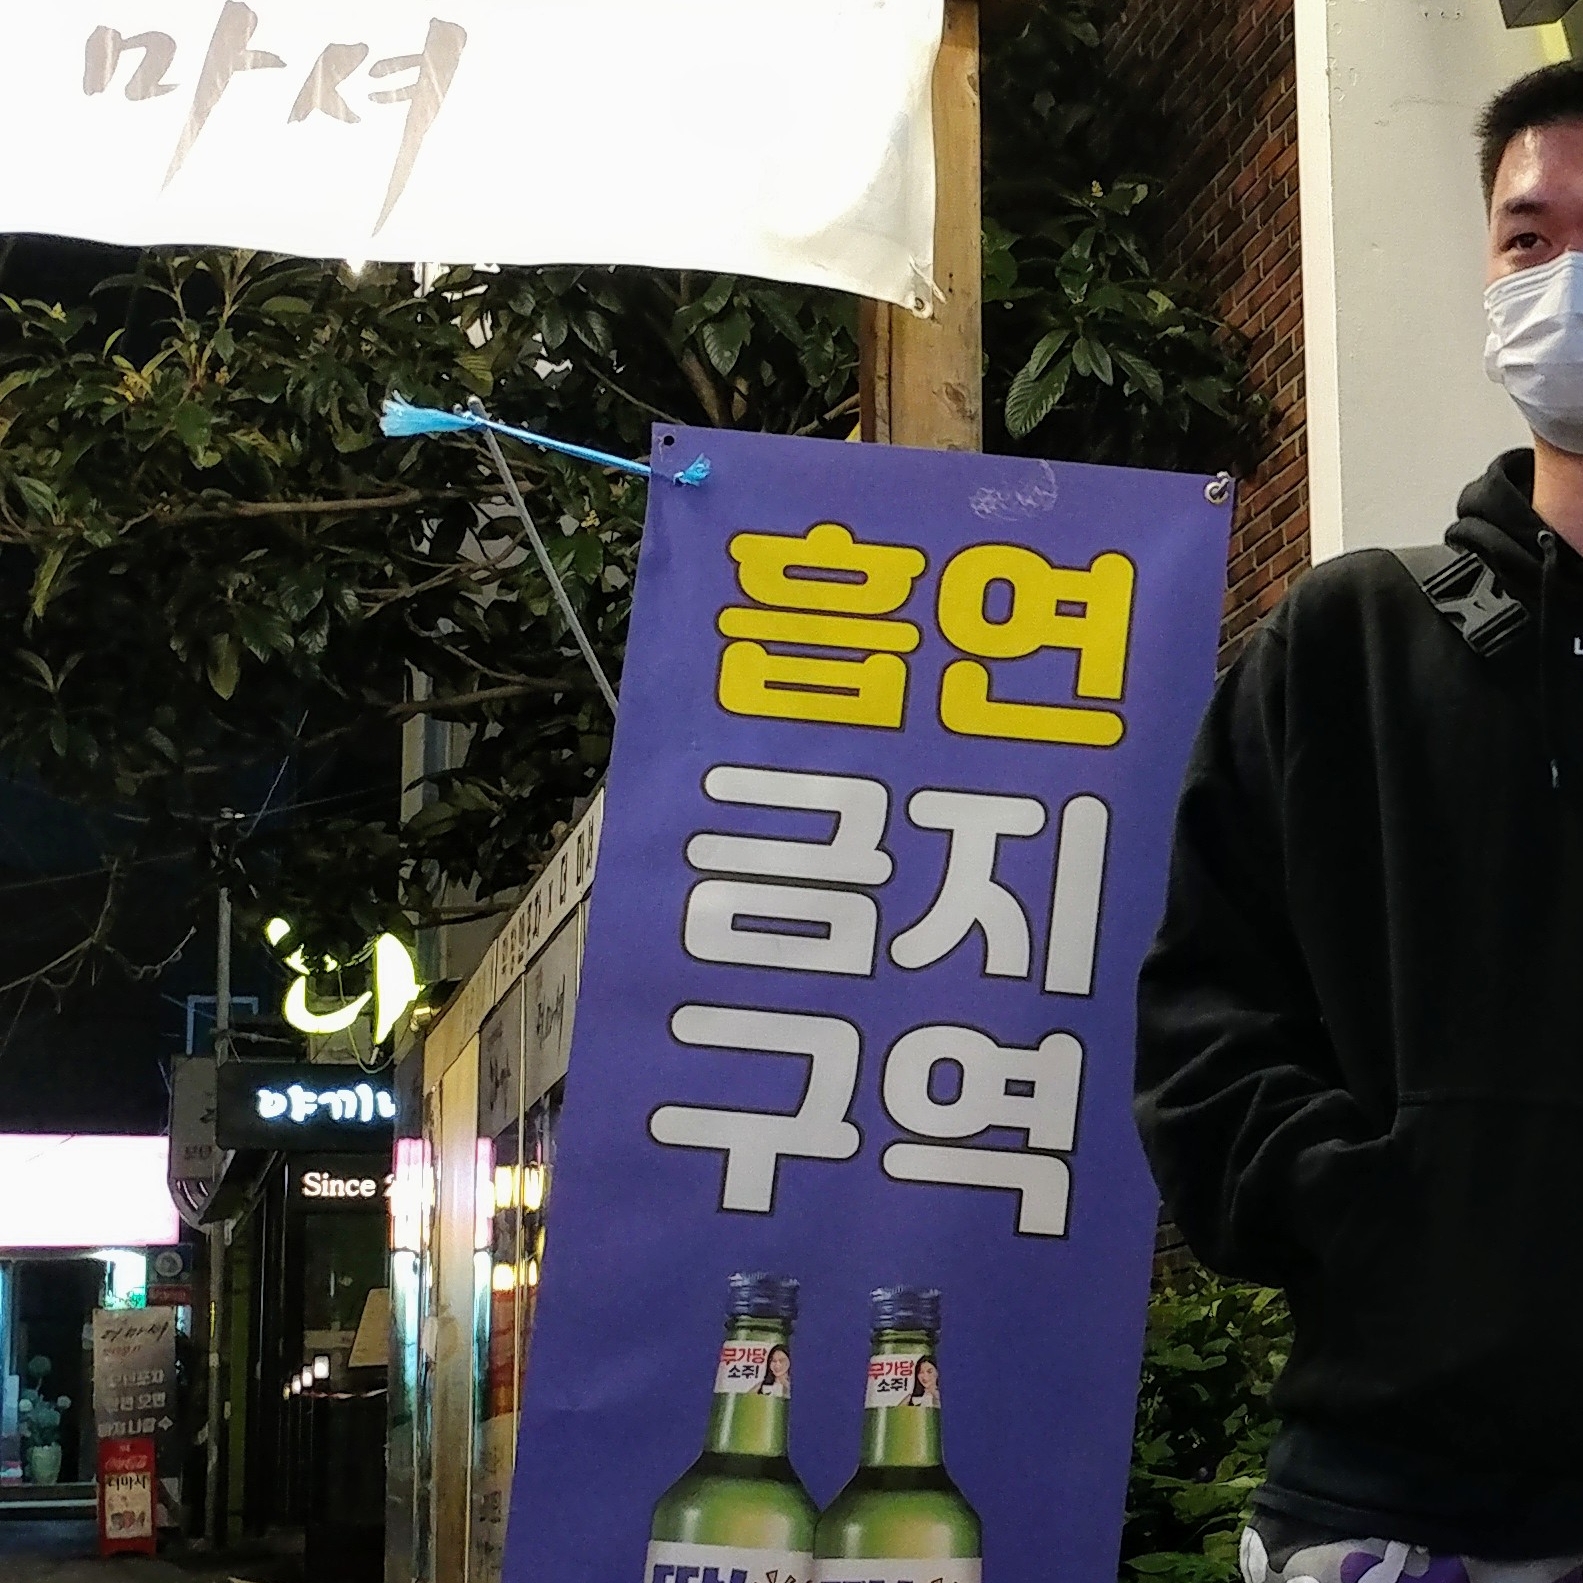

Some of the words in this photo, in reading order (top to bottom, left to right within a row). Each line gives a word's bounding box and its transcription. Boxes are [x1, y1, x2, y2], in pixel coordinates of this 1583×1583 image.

[83, 0, 467, 237] 마셔
[714, 520, 1137, 748] 흡연
[681, 764, 1112, 998] 금지
[303, 1172, 376, 1198] Since
[649, 1002, 1086, 1238] 구역
